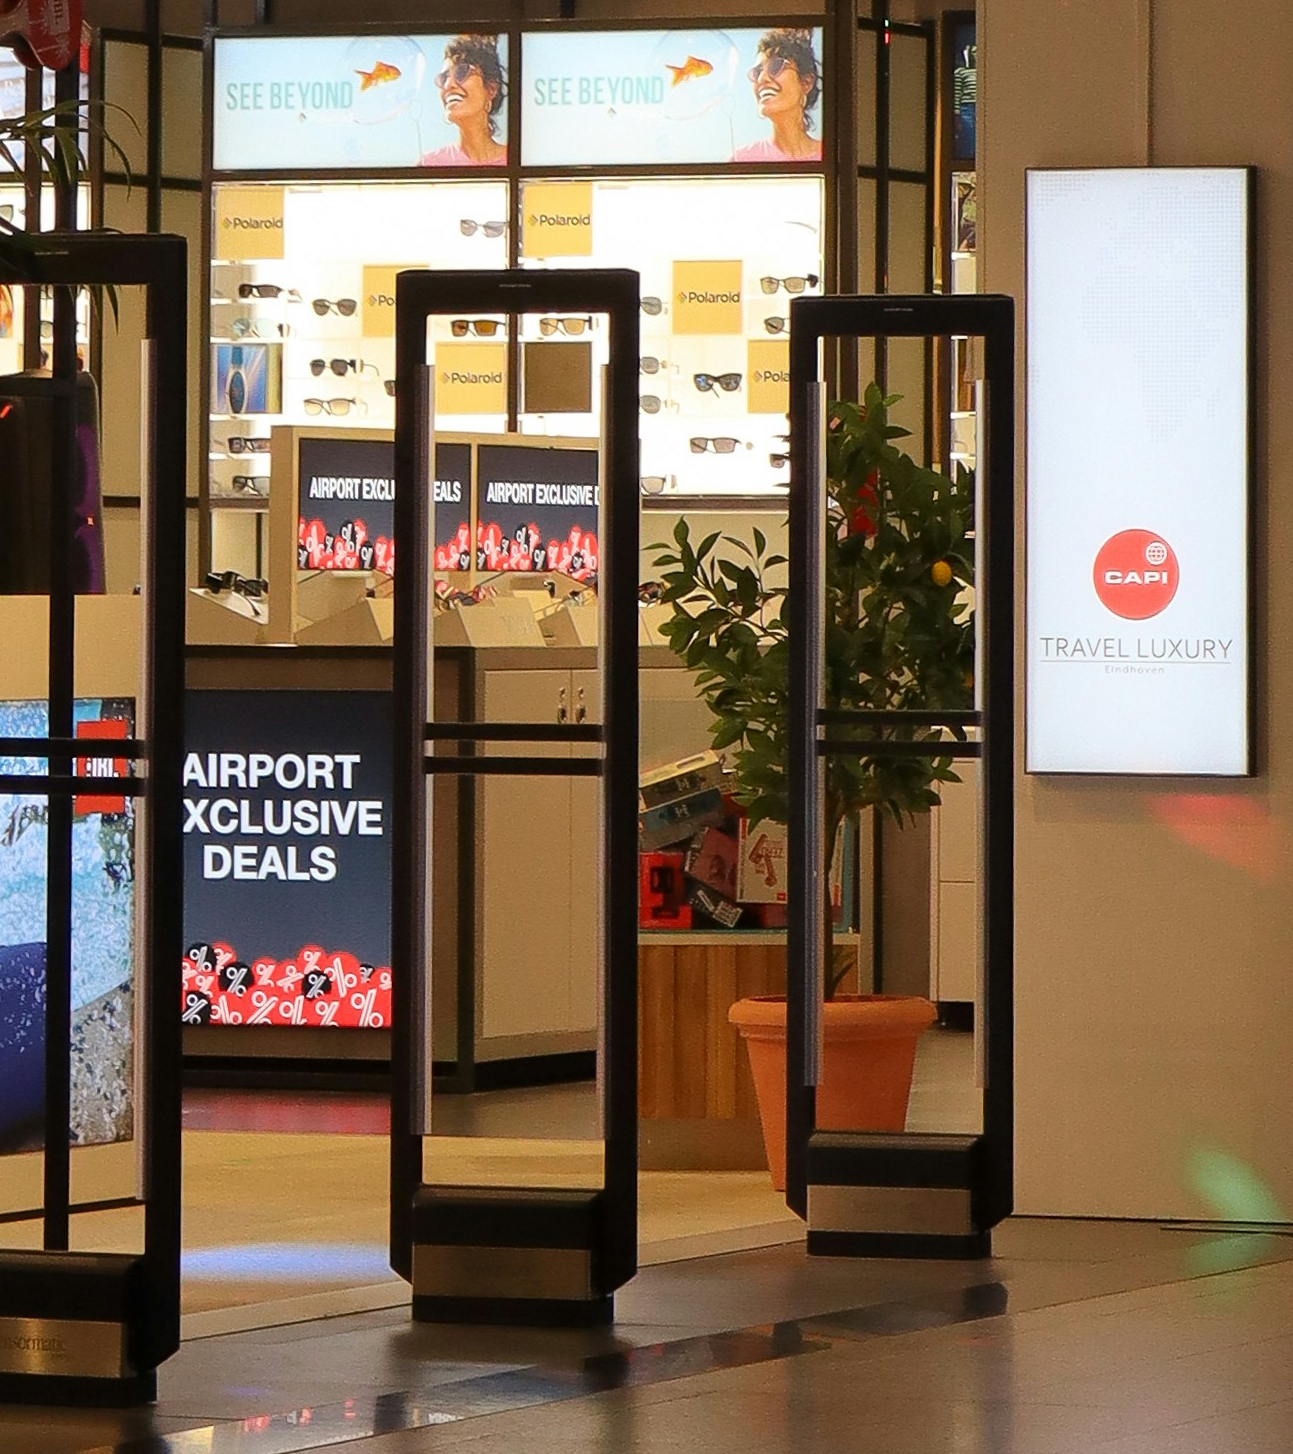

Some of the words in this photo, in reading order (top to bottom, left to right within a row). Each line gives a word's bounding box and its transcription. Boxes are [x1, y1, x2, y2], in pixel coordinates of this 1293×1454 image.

[225, 81, 264, 111] SEE
[269, 80, 354, 110] BEYOND
[534, 77, 572, 106] SEE
[578, 76, 665, 105] BEYOND
[232, 216, 284, 230] Polaroid
[539, 213, 591, 227] Polaroid
[687, 290, 741, 305] Polaroid
[450, 371, 503, 385] Polaroid
[762, 369, 790, 383] Pola
[309, 476, 361, 500] AIRPORT
[434, 480, 462, 502] EALS
[486, 482, 535, 504] AIRPORT
[535, 484, 594, 506] EXCLUSIVE
[1103, 569, 1169, 585] CAPI
[1039, 636, 1131, 659] TRAVEL
[1137, 638, 1234, 660] LUXURY
[1104, 665, 1166, 675] Eindhoven
[182, 752, 361, 790] AIRPORT
[182, 798, 384, 836] XCLUSIVE
[203, 844, 338, 882] DEALS
